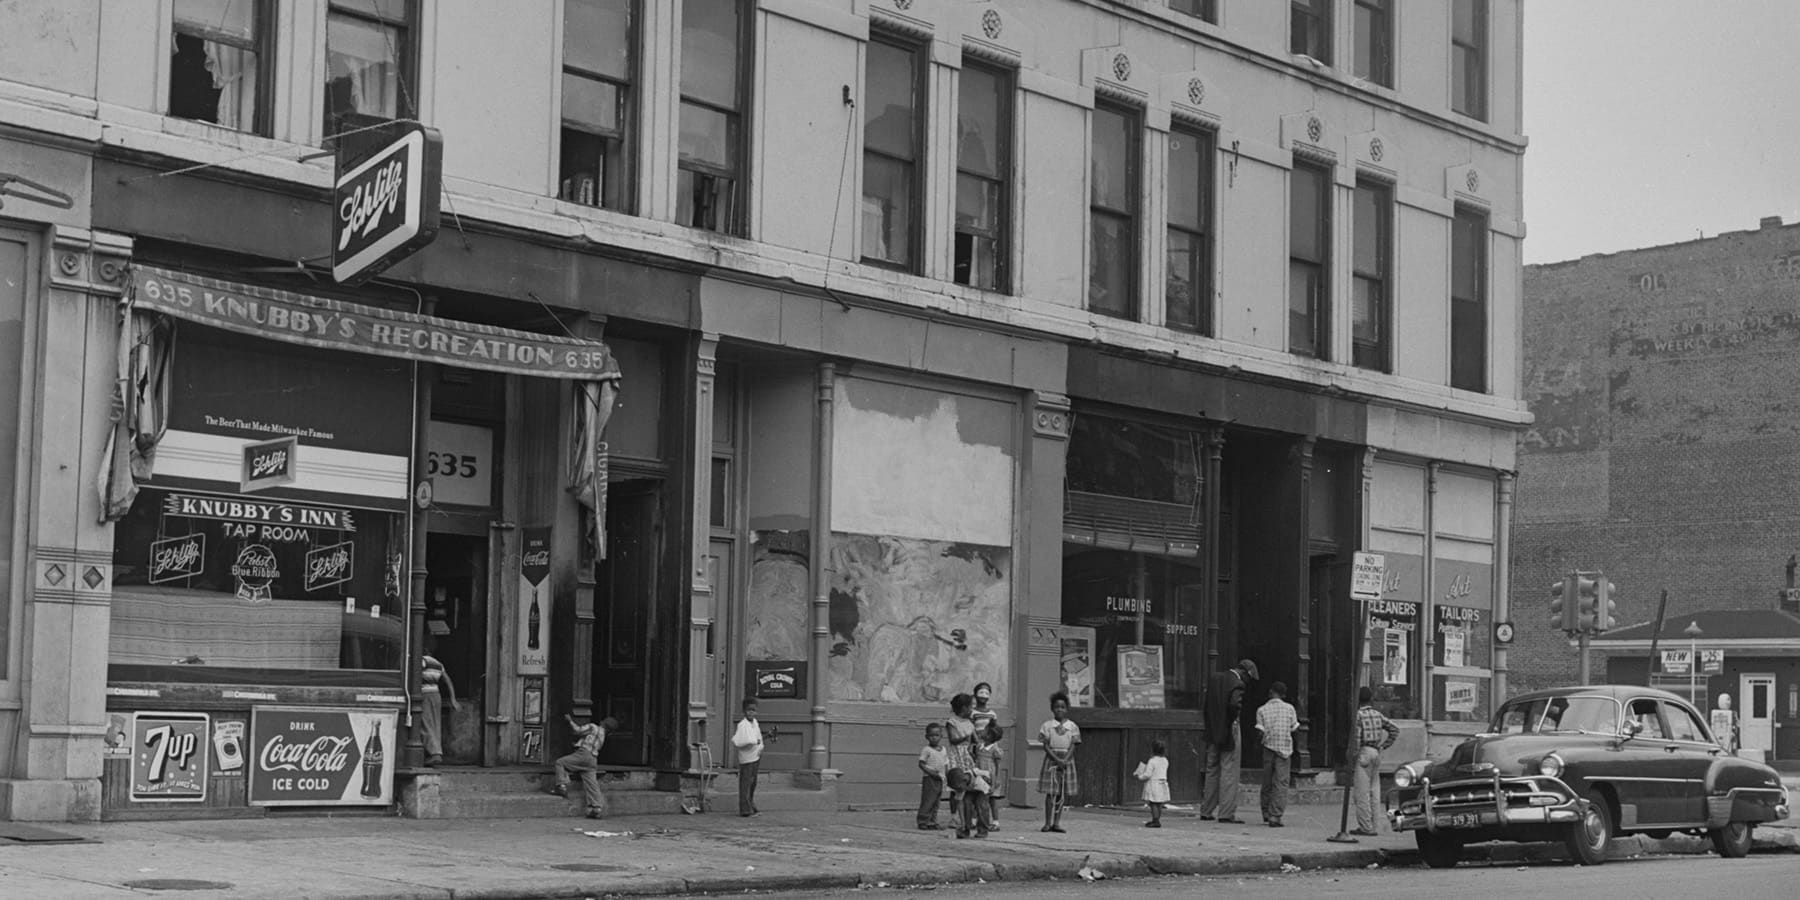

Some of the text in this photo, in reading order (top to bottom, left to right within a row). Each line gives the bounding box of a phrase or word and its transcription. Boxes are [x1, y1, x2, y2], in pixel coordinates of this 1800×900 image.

[339, 159, 403, 251] Schlitz
[144, 280, 604, 370] 635 KNUBBY'S RECREATION 635
[204, 415, 218, 426] The
[219, 417, 235, 428] Beer
[235, 419, 251, 430] That
[252, 421, 271, 432] Made
[308, 428, 334, 440] Famous
[252, 450, 286, 477] Schlitz
[428, 451, 477, 478] 635
[182, 497, 336, 526] KNUBBY'S INN
[223, 522, 310, 543] TAP ROOM
[154, 539, 200, 575] Schlitz
[242, 550, 272, 566] Pabst
[1365, 556, 1375, 565] NO
[232, 565, 280, 578] Blue Ribbon
[309, 550, 350, 584] Schlitz
[1355, 564, 1384, 574] PARKING
[1445, 576, 1472, 599] Art
[1107, 596, 1152, 613] PLUMBING
[1368, 600, 1417, 616] CLEANERS
[1440, 606, 1480, 621] TAILORS
[1166, 624, 1198, 636] SUPPLIES
[1666, 652, 1687, 661] NEW
[290, 721, 315, 731] DRINK
[260, 735, 354, 772] Coca-Cola
[272, 778, 330, 791] ICE COLD
